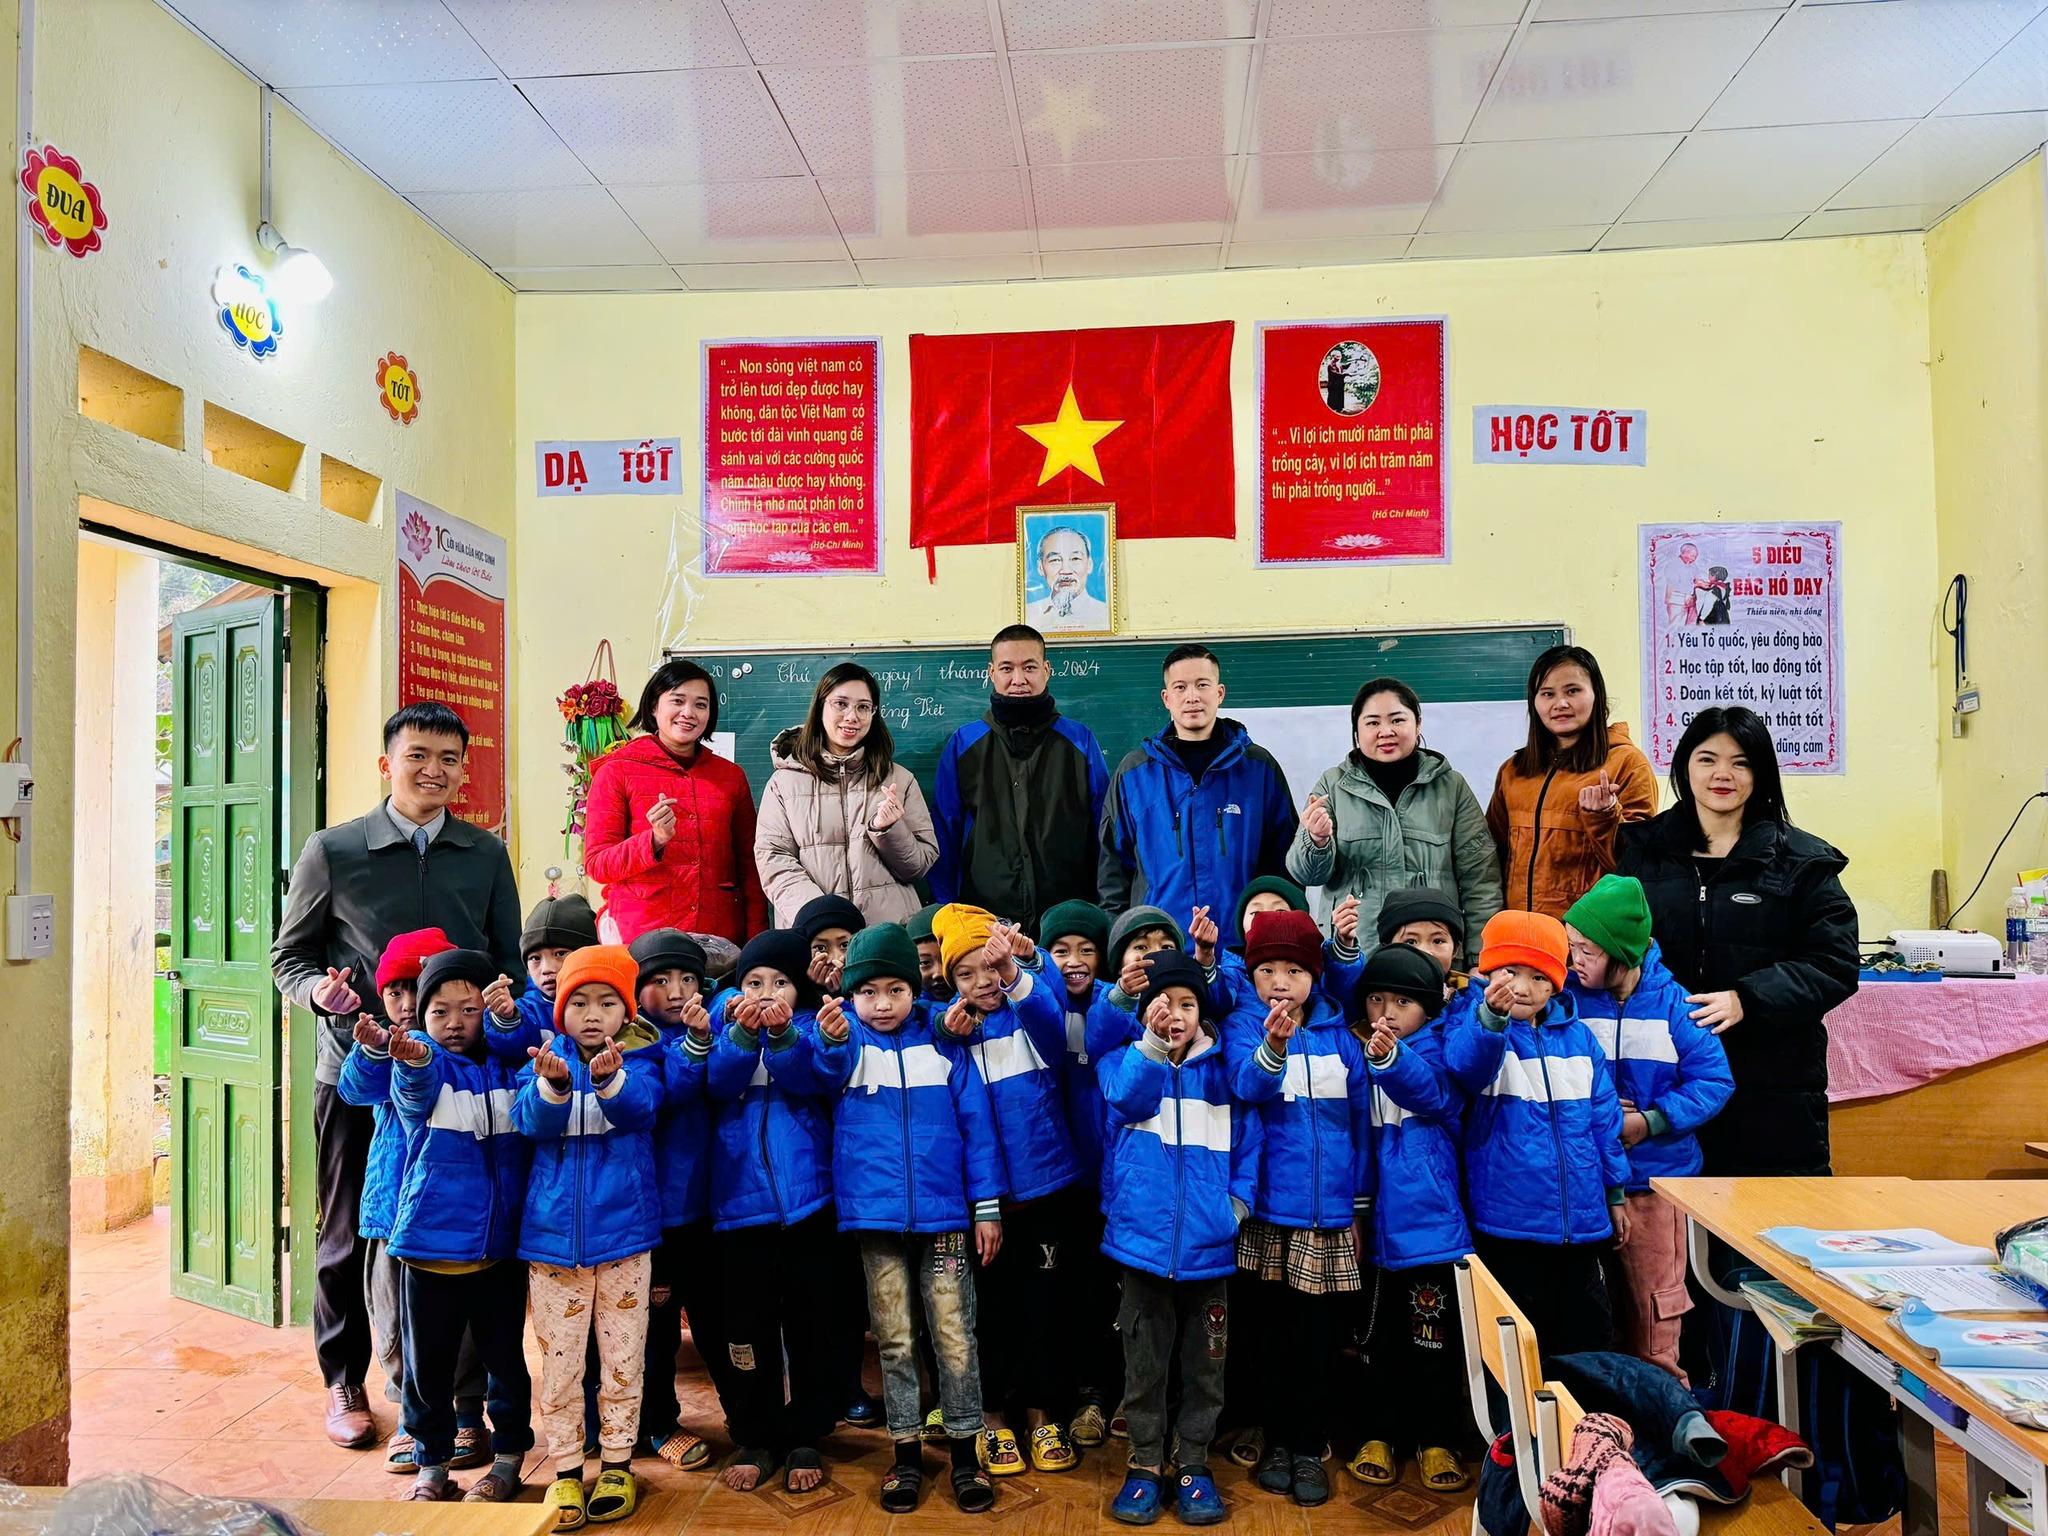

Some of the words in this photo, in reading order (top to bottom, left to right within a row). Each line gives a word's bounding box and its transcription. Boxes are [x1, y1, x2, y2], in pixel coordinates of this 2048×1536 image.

[46, 183, 85, 222] ĐUA
[236, 303, 265, 329] HỌC
[739, 359, 762, 373] Non
[766, 358, 794, 377] sông
[797, 358, 818, 377] việt
[821, 361, 845, 372] nam
[849, 357, 863, 372] có
[391, 377, 410, 402] TỐT
[720, 379, 737, 397] trở
[740, 382, 757, 397] lên
[761, 381, 782, 396] tươi
[786, 381, 807, 400] đẹp
[811, 380, 839, 399] được
[843, 380, 864, 399] hay
[721, 405, 756, 423] không,
[759, 405, 778, 419] dân
[781, 404, 797, 422] tộc
[800, 403, 820, 422] Việt
[823, 404, 846, 418] Nam
[852, 403, 865, 418] có
[721, 428, 748, 442] bước
[751, 427, 765, 442] tới
[768, 426, 784, 442] đài
[787, 428, 810, 442] vinh
[813, 430, 847, 445] quang
[850, 421, 864, 442] để
[1290, 427, 1300, 444] Vì
[1303, 426, 1316, 448] lợi
[1319, 426, 1335, 443] ích
[1338, 425, 1365, 442] mười
[1368, 425, 1390, 441] năm
[1410, 420, 1433, 444] phải
[1491, 414, 1559, 457] HỌC
[1570, 410, 1633, 453] TỐT
[544, 450, 588, 492] DẠ
[619, 439, 673, 483] TỐT
[721, 450, 745, 465] sánh
[748, 450, 763, 465] vai
[766, 450, 781, 465] với
[784, 450, 801, 465] các
[804, 450, 836, 468] cường
[838, 447, 864, 467] quốc
[1272, 452, 1302, 476] trồng
[1305, 453, 1327, 475] cây,
[1330, 453, 1340, 470] vì
[1343, 453, 1356, 474] lợi
[1360, 451, 1376, 469] ích
[1380, 451, 1406, 468] trăm
[1409, 451, 1433, 468] năm
[721, 474, 744, 489] năm
[747, 473, 773, 488] châu
[776, 472, 803, 491] được
[807, 473, 825, 491] hay
[1289, 479, 1311, 503] phải
[1314, 478, 1343, 501] trồng
[721, 496, 751, 512] Chính
[754, 496, 762, 512] là
[766, 496, 785, 511] nhờ
[788, 497, 807, 514] một
[810, 494, 835, 513] phần
[838, 496, 854, 510] lớn
[857, 492, 864, 510] ở
[1406, 509, 1429, 519] Minh)
[750, 519, 769, 536] học
[791, 516, 810, 533] của
[813, 518, 831, 533] các
[1752, 547, 1761, 564] 5
[1767, 539, 1802, 564] ĐIỀU
[1733, 573, 1763, 596] BÁC
[1768, 570, 1788, 596] HỒ
[1793, 578, 1822, 600] DẠY
[1665, 634, 1674, 648] 1.
[1677, 632, 1698, 648] Yêu
[1702, 628, 1715, 648] Tổ
[1718, 631, 1748, 651] quốc,
[1751, 633, 1769, 651] yêu
[1773, 628, 1799, 650] đồng
[1803, 632, 1822, 647] bào
[777, 662, 811, 683] Thứ
[914, 664, 923, 680] 1
[939, 660, 990, 689] tháng
[1058, 659, 1100, 676] 2024
[1665, 660, 1675, 674] 2.
[1680, 659, 1701, 678] Học
[1705, 659, 1724, 678] tập
[1728, 656, 1748, 677] tốt,
[1752, 659, 1769, 673] lao
[1773, 657, 1801, 678] động
[1805, 655, 1822, 674] tốt
[1666, 687, 1676, 700] 3.
[1680, 686, 1710, 700] Đoàn
[1715, 683, 1734, 700] kết
[1738, 681, 1757, 703] tốt,
[1761, 683, 1775, 704] kỷ
[1779, 686, 1801, 704] luật
[1806, 681, 1822, 700] tốt
[880, 703, 911, 729] ếng
[1666, 713, 1677, 726] 4.
[1776, 711, 1802, 731] thật
[1806, 708, 1823, 727] tốt
[1776, 738, 1800, 755] dũng
[1803, 736, 1823, 753] cảm
